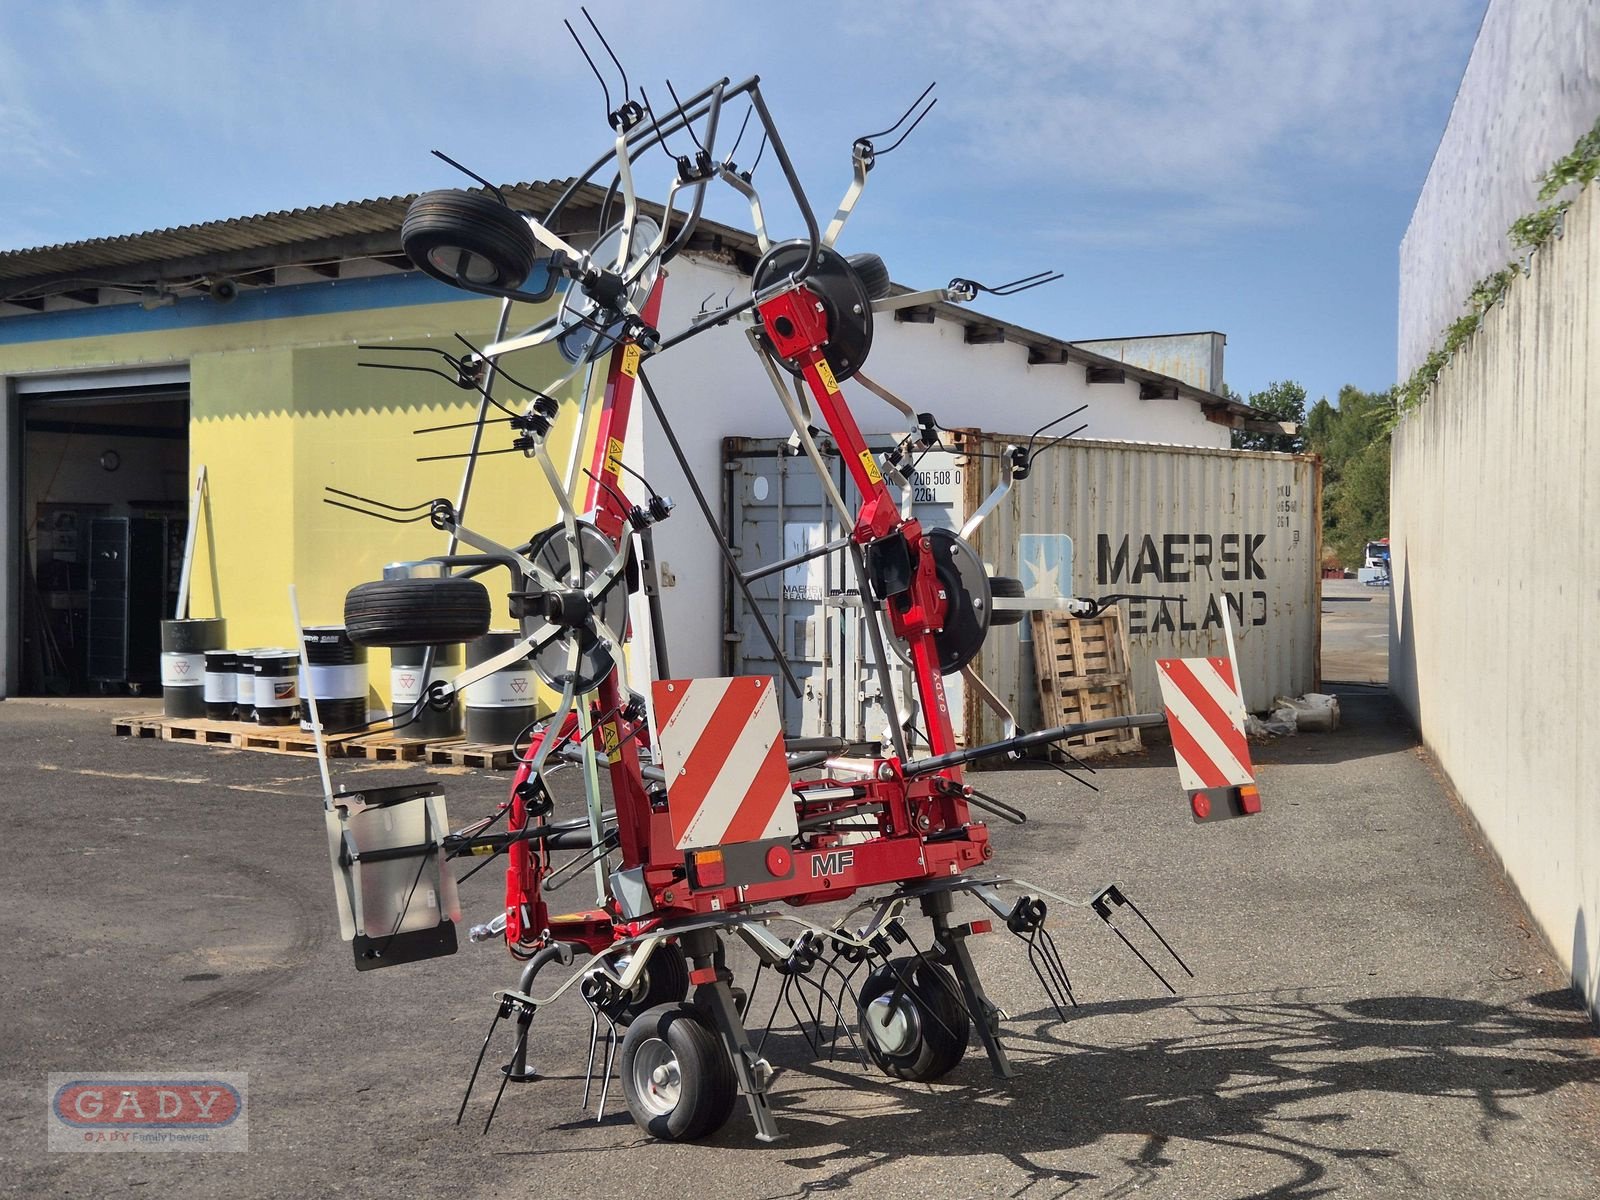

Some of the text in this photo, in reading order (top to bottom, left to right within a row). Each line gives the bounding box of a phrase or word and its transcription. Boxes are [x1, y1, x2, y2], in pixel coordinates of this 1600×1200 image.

[914, 471, 931, 486] 206
[933, 471, 951, 485] 508
[914, 488, 936, 502] 22G1
[1097, 534, 1266, 584] MAERSK
[1112, 591, 1267, 634] EALAND
[811, 850, 854, 878] MF
